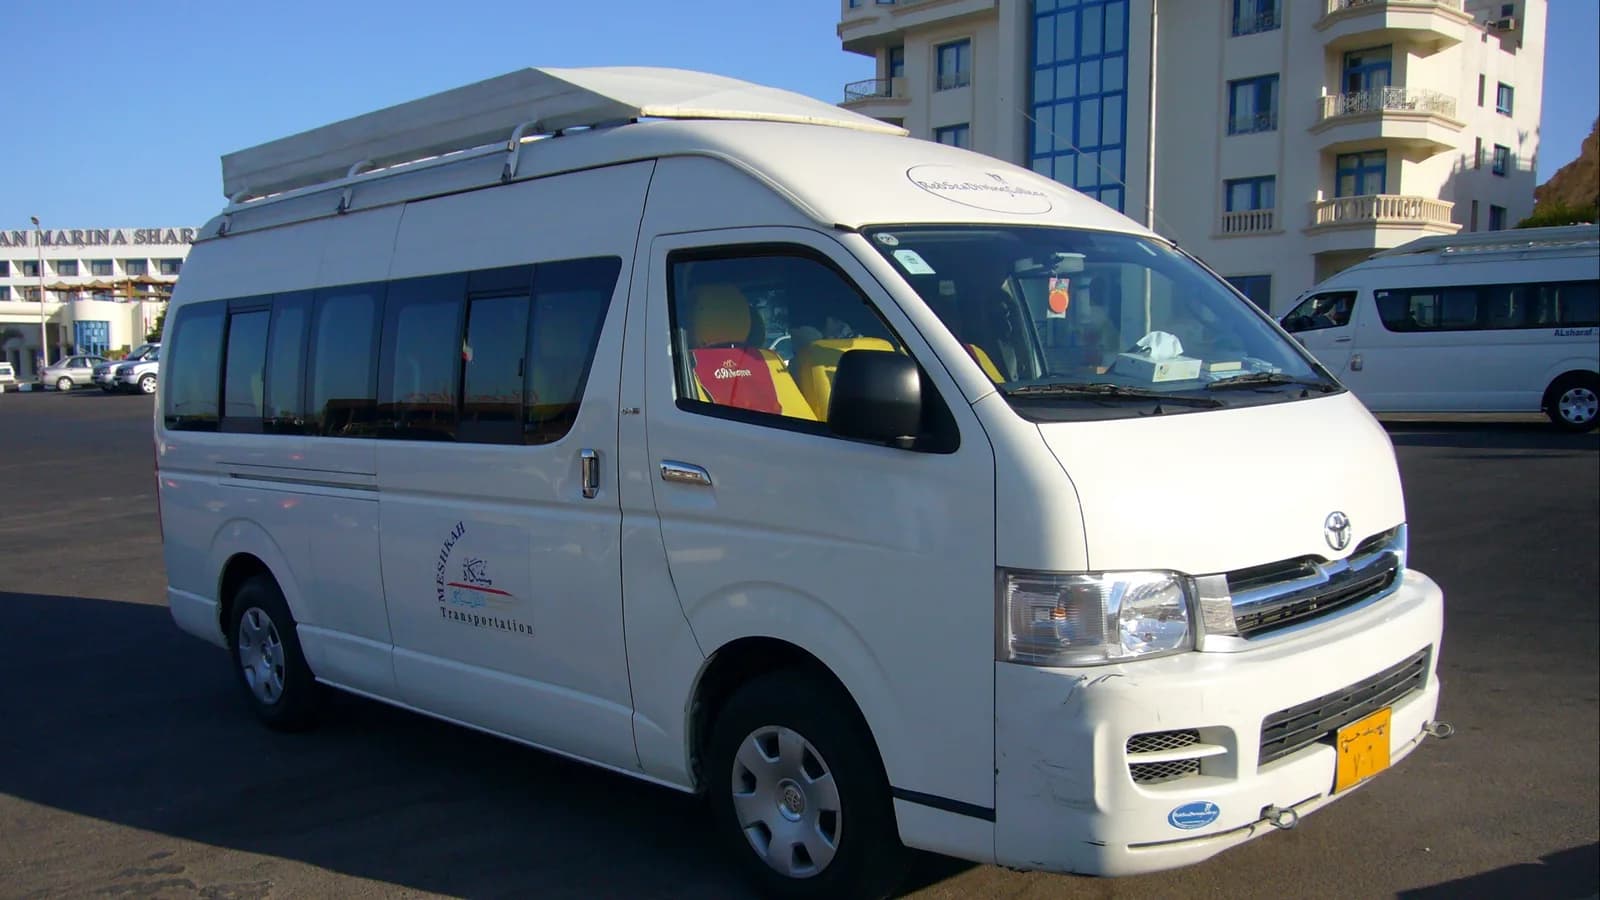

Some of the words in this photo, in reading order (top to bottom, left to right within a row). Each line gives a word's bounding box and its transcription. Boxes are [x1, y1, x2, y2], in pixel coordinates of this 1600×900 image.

[35, 229, 128, 248] MARINA
[436, 520, 466, 602] MESHKAH
[440, 606, 534, 635] Transportation
